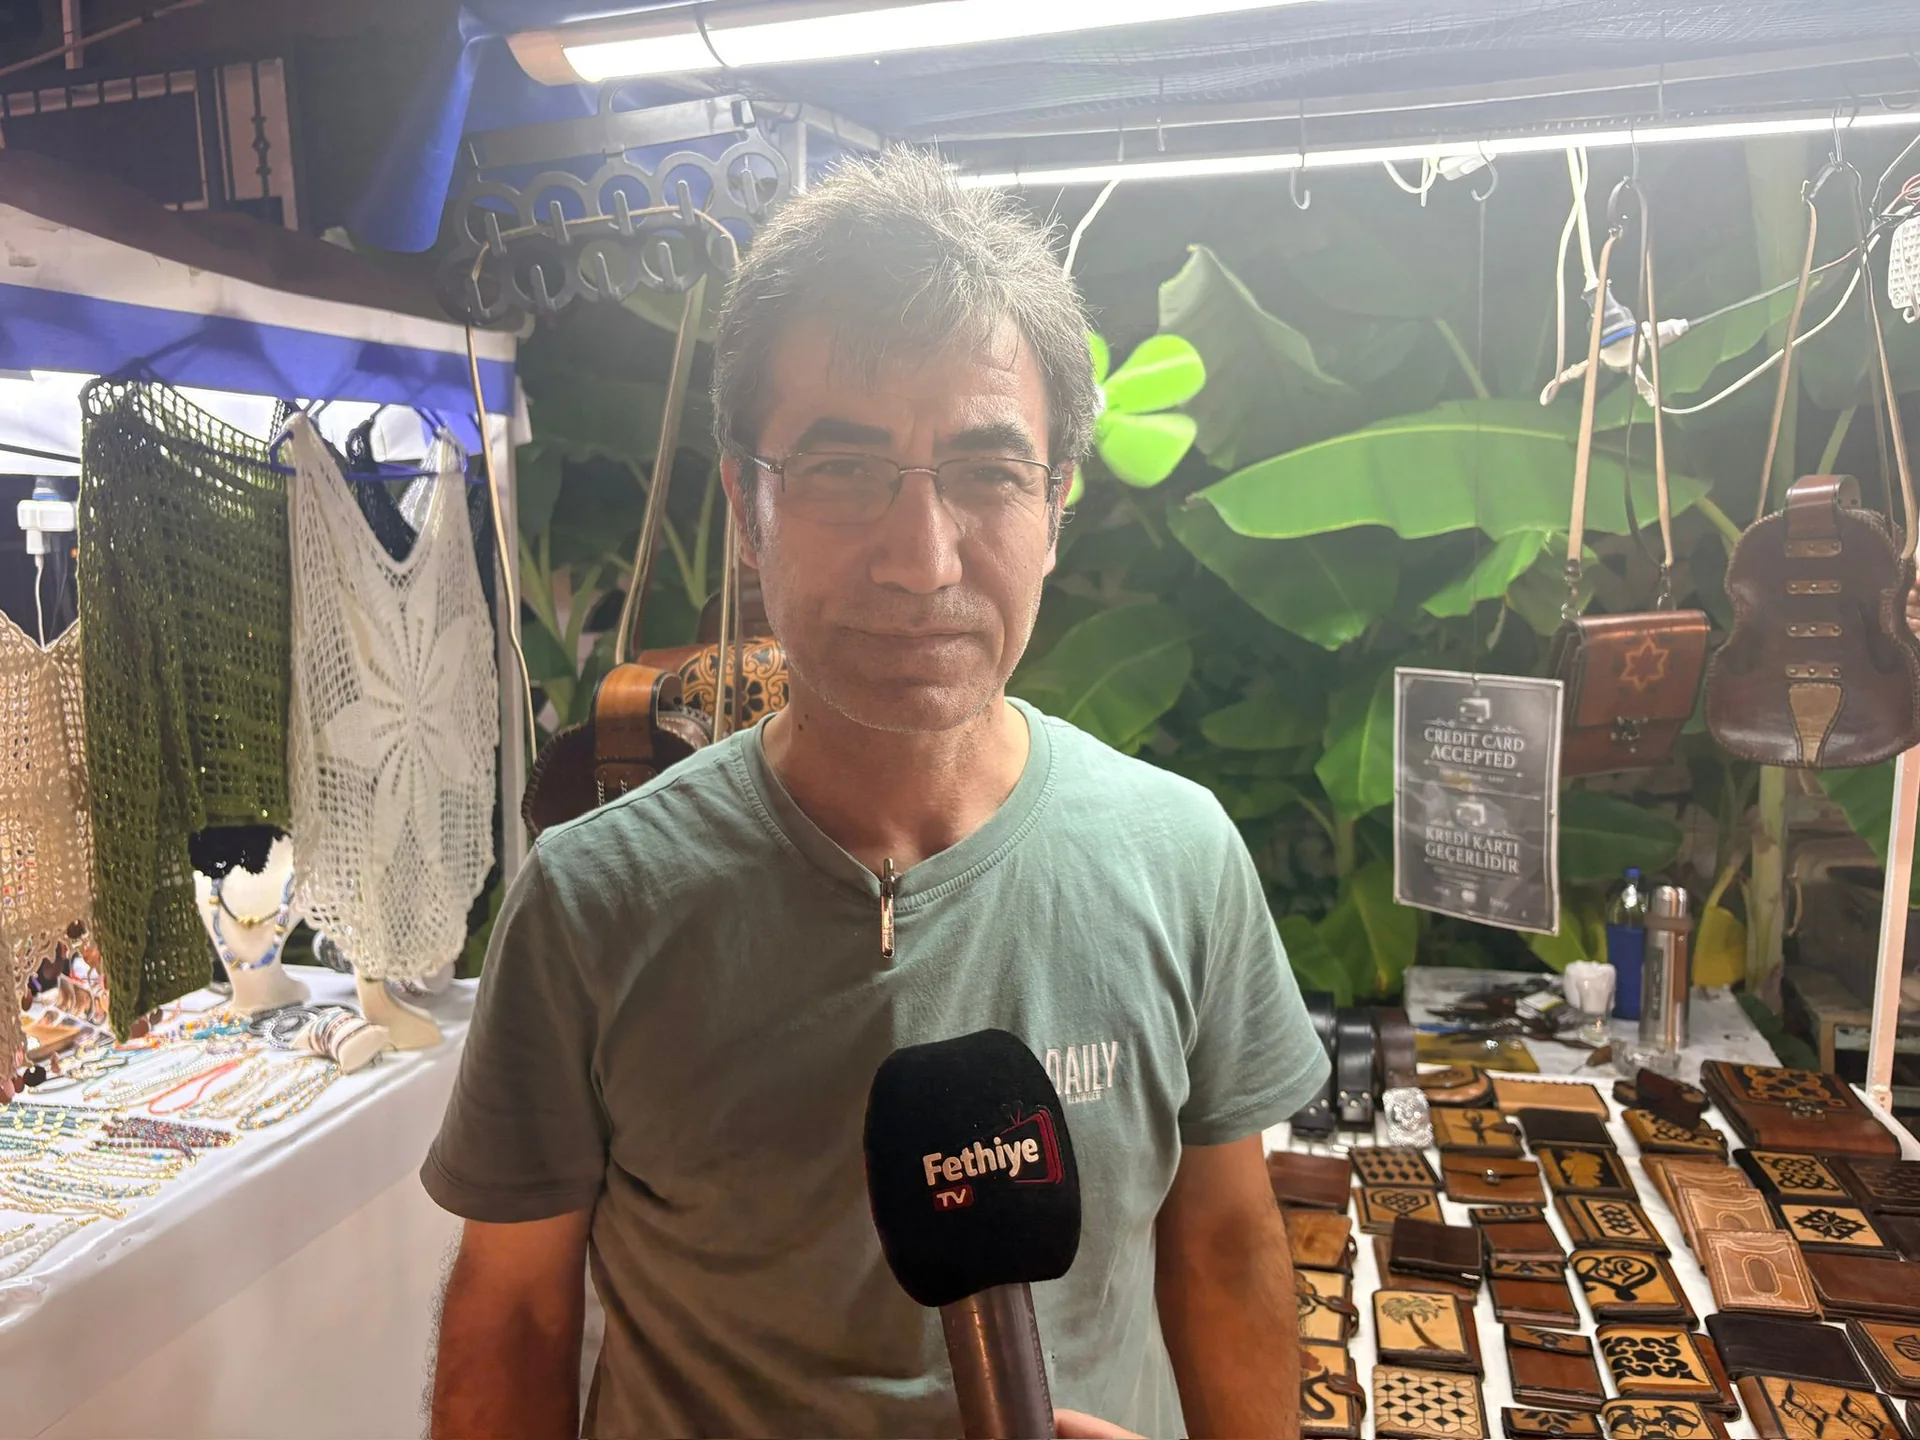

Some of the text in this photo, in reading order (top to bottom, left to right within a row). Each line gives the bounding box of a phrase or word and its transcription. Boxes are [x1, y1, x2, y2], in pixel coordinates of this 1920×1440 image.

[1424, 727, 1525, 752] CREDIT CARD
[1431, 745, 1516, 769] ACCEPTED
[1472, 836, 1519, 857] KARTI
[1045, 1041, 1118, 1095] DAILY
[922, 1137, 1039, 1186] Fethiye
[936, 1188, 967, 1207] TV
